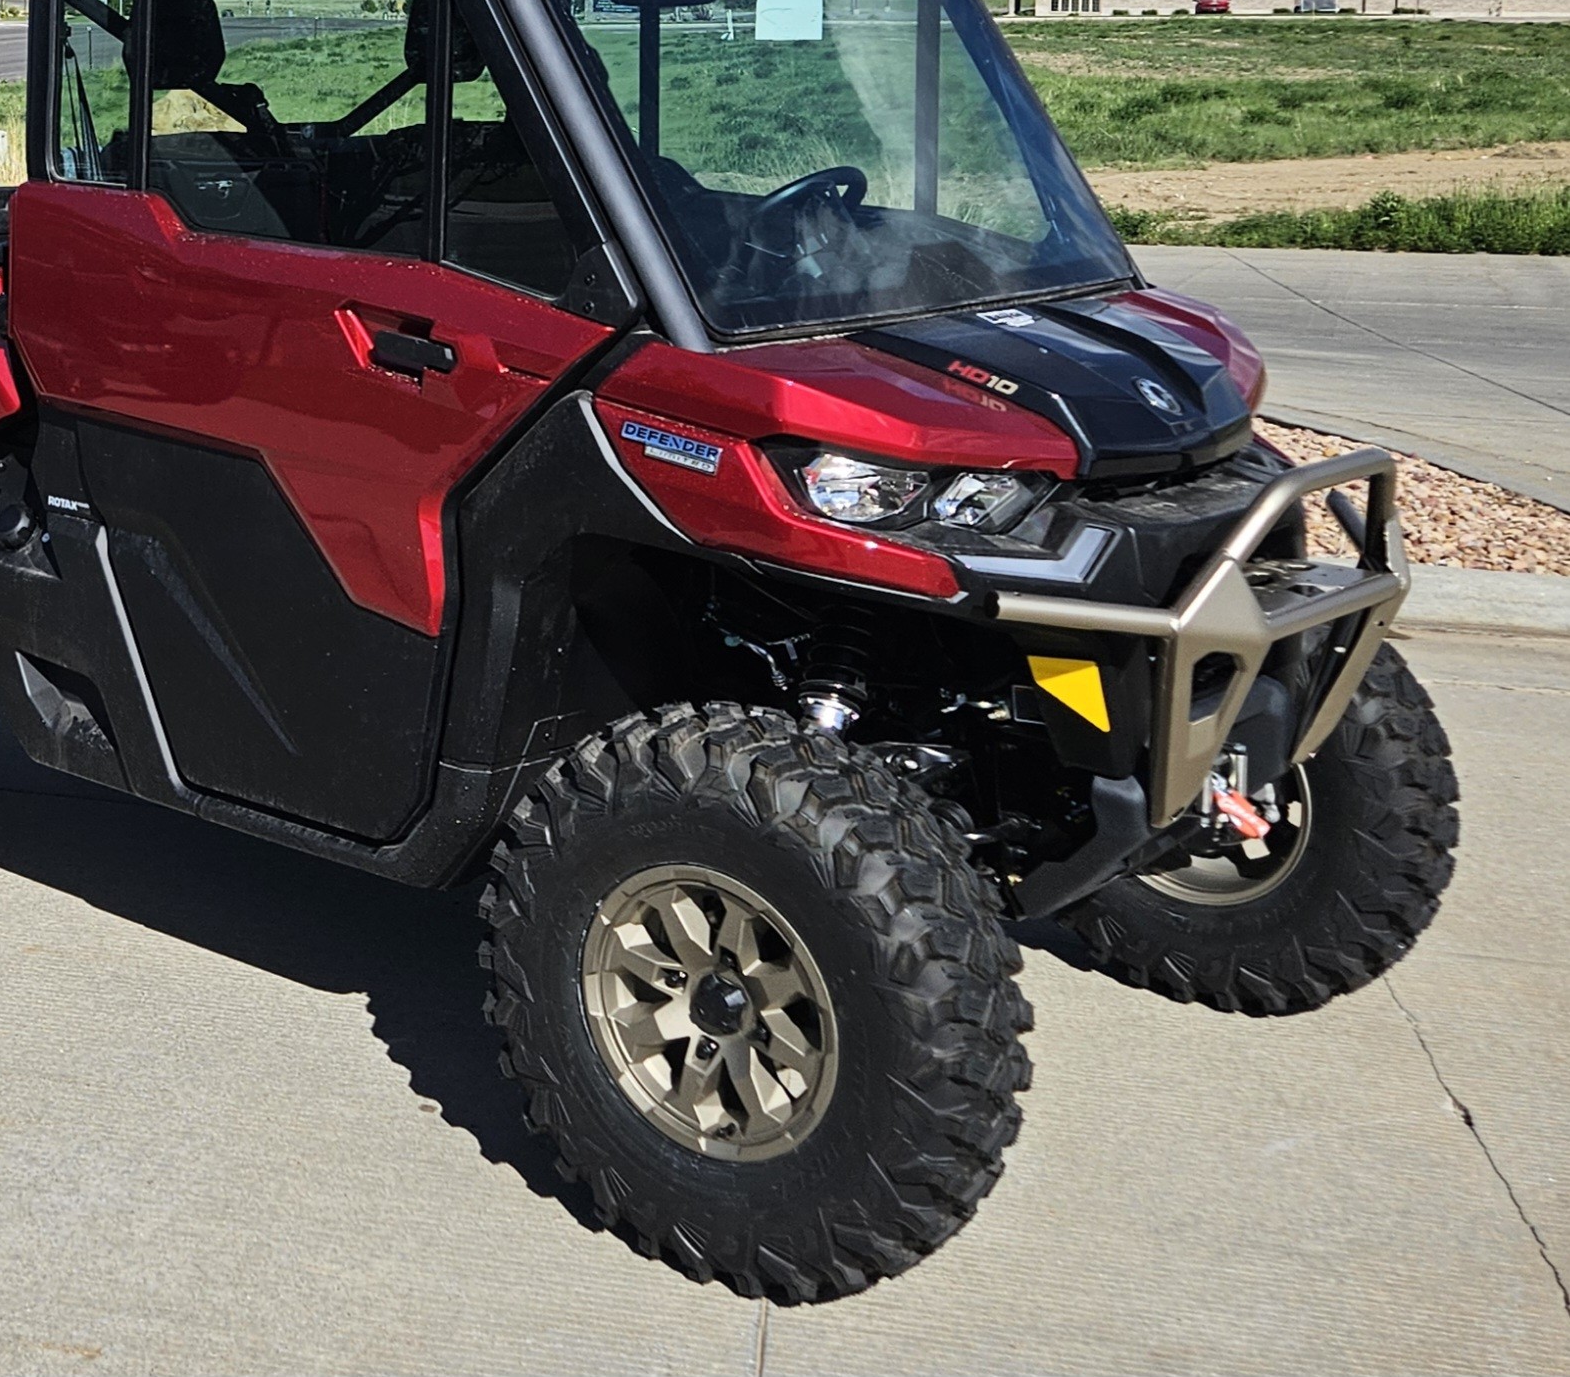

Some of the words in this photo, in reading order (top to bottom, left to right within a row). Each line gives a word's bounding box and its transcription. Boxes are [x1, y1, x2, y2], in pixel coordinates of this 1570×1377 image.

[947, 360, 1019, 395] HD10
[623, 423, 719, 460] DEFENDER
[47, 495, 78, 511] ROTAX
